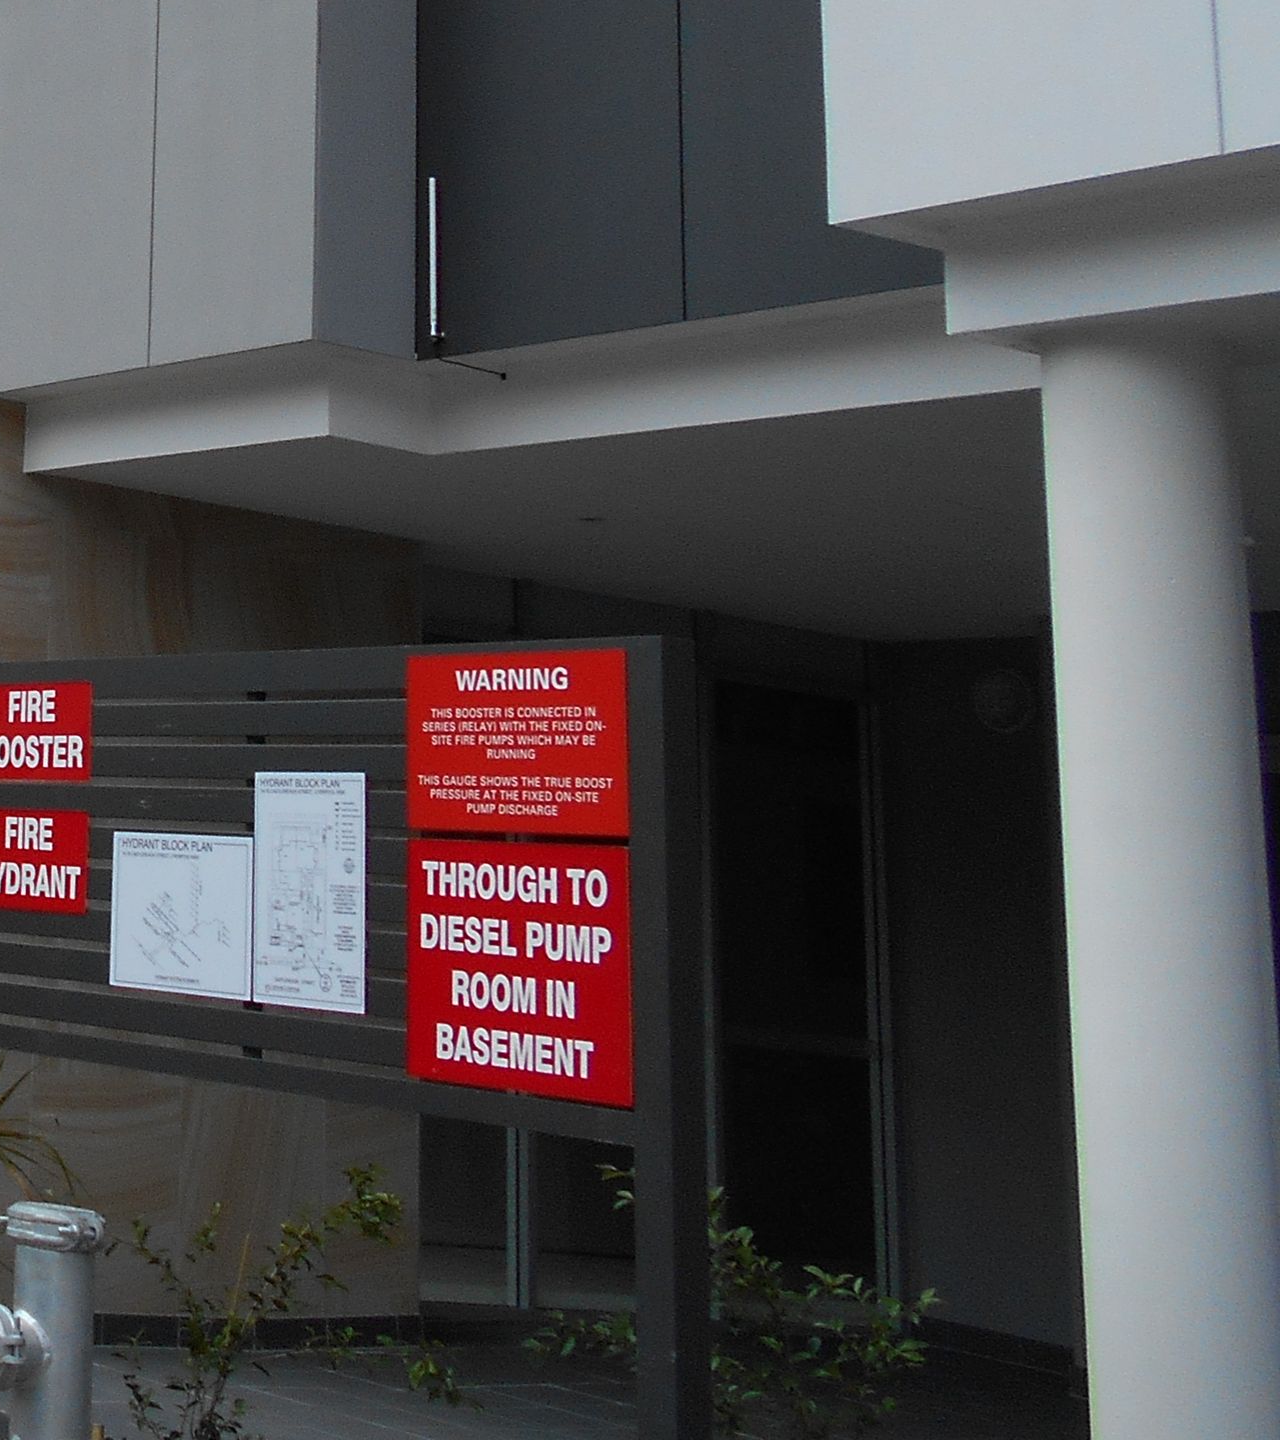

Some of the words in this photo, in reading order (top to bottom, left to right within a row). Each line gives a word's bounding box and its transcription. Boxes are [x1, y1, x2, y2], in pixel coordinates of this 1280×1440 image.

[455, 666, 569, 692] WARNING
[8, 689, 57, 723] FIRE
[431, 708, 453, 719] THIS
[455, 707, 501, 719] BOOSTER
[504, 707, 514, 718] IS
[516, 707, 581, 718] CONNECTED
[584, 706, 596, 717] IN
[422, 721, 456, 732] SERIES
[458, 721, 497, 733] (RELAY)
[500, 721, 526, 732] WITH
[529, 720, 548, 731] THE
[551, 720, 583, 732] FIXED
[585, 720, 607, 732] ON-
[431, 735, 452, 746] SITE
[454, 735, 476, 745] FIRE
[478, 735, 514, 745] PUMPS
[516, 735, 552, 745] WHICH
[554, 735, 579, 746] MAY
[582, 735, 596, 746] BE
[486, 748, 536, 760] RUNNING
[260, 778, 293, 788] HYDRANT
[295, 778, 321, 788] BLOCK
[321, 779, 341, 788] PLAN
[417, 774, 440, 786] THIS
[442, 775, 477, 787] GAUGE
[480, 775, 518, 787] SHOWS
[521, 776, 541, 788] THE
[544, 776, 572, 788] TRUE
[575, 777, 614, 789] BOOST
[429, 788, 480, 800] PRESSURE
[483, 789, 498, 801] AT
[500, 790, 520, 801] THE
[522, 790, 553, 802] FIXED
[555, 790, 599, 803] ON-SITE
[466, 803, 496, 814] PUMP
[498, 803, 559, 816] DISCHARGE
[4, 816, 54, 851] FIRE
[122, 838, 160, 850] HYDRANT
[161, 840, 190, 852] BLOCK
[191, 841, 214, 852] PLAN
[422, 860, 558, 904] THROUGH
[566, 868, 608, 908] TO
[420, 913, 518, 957] DIESEL
[526, 921, 612, 964] PUMP
[451, 969, 536, 1015] ROOM
[546, 979, 576, 1019] IN
[436, 1022, 594, 1079] BASEMENT
